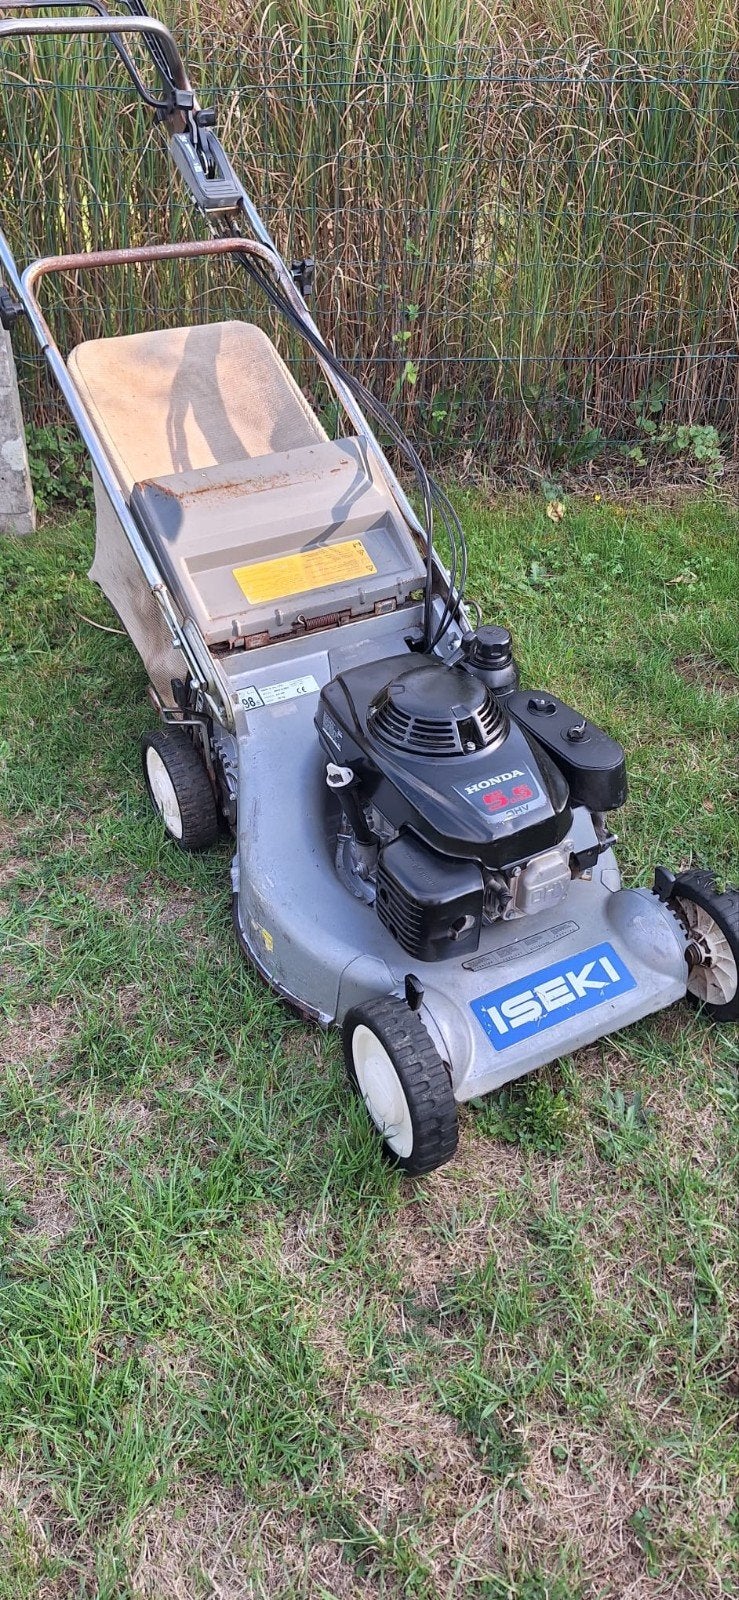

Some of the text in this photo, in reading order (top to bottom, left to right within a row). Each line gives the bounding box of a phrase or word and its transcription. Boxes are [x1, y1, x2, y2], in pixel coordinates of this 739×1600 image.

[464, 769, 526, 795] HONDA
[482, 784, 533, 812] 5.5
[487, 956, 621, 1035] ISEKI
